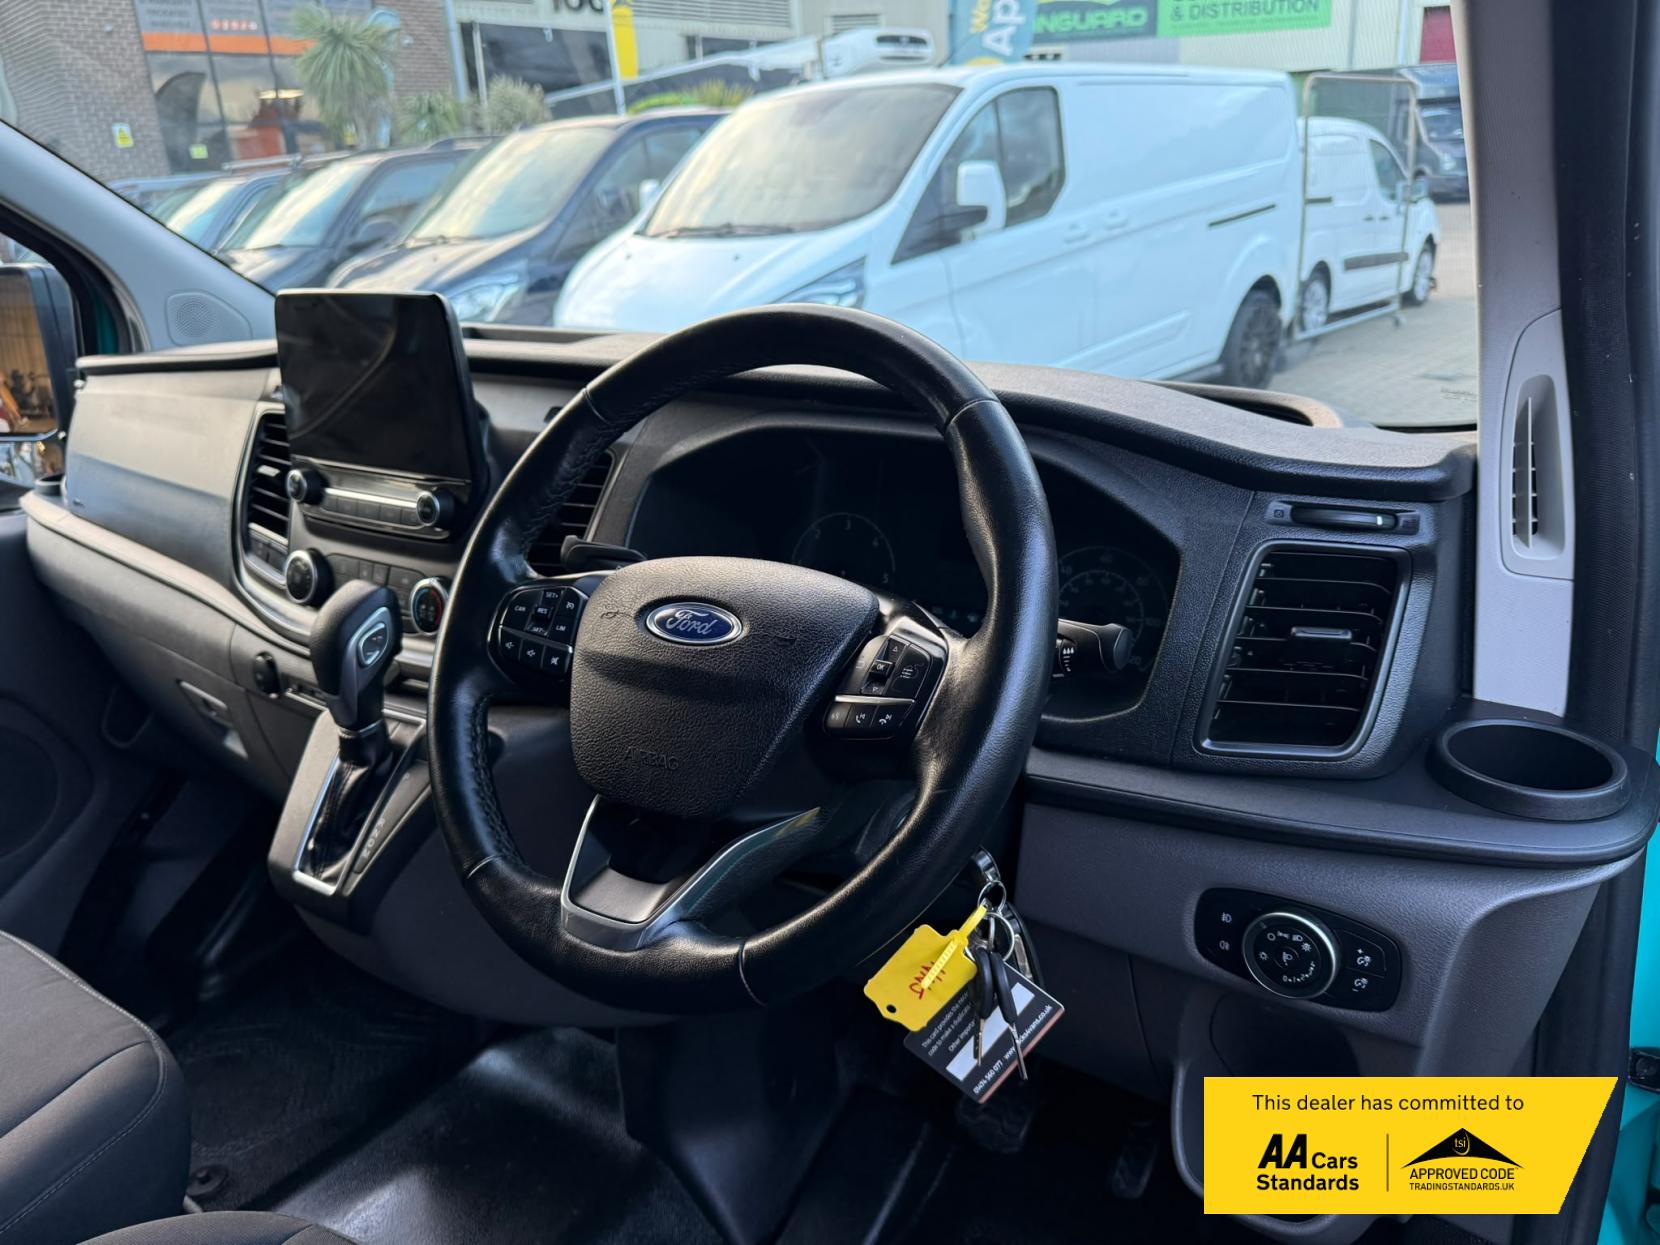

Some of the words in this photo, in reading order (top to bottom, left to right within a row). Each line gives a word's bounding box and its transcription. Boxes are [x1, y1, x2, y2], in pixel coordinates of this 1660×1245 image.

[1035, 7, 1148, 33] NGUARD
[1189, 0, 1320, 20] DISTRIBUTION
[666, 609, 718, 635] Ford
[921, 1036, 932, 1048] This
[928, 1026, 940, 1039] card
[936, 1009, 955, 1030] provides
[948, 1036, 962, 1051] Other
